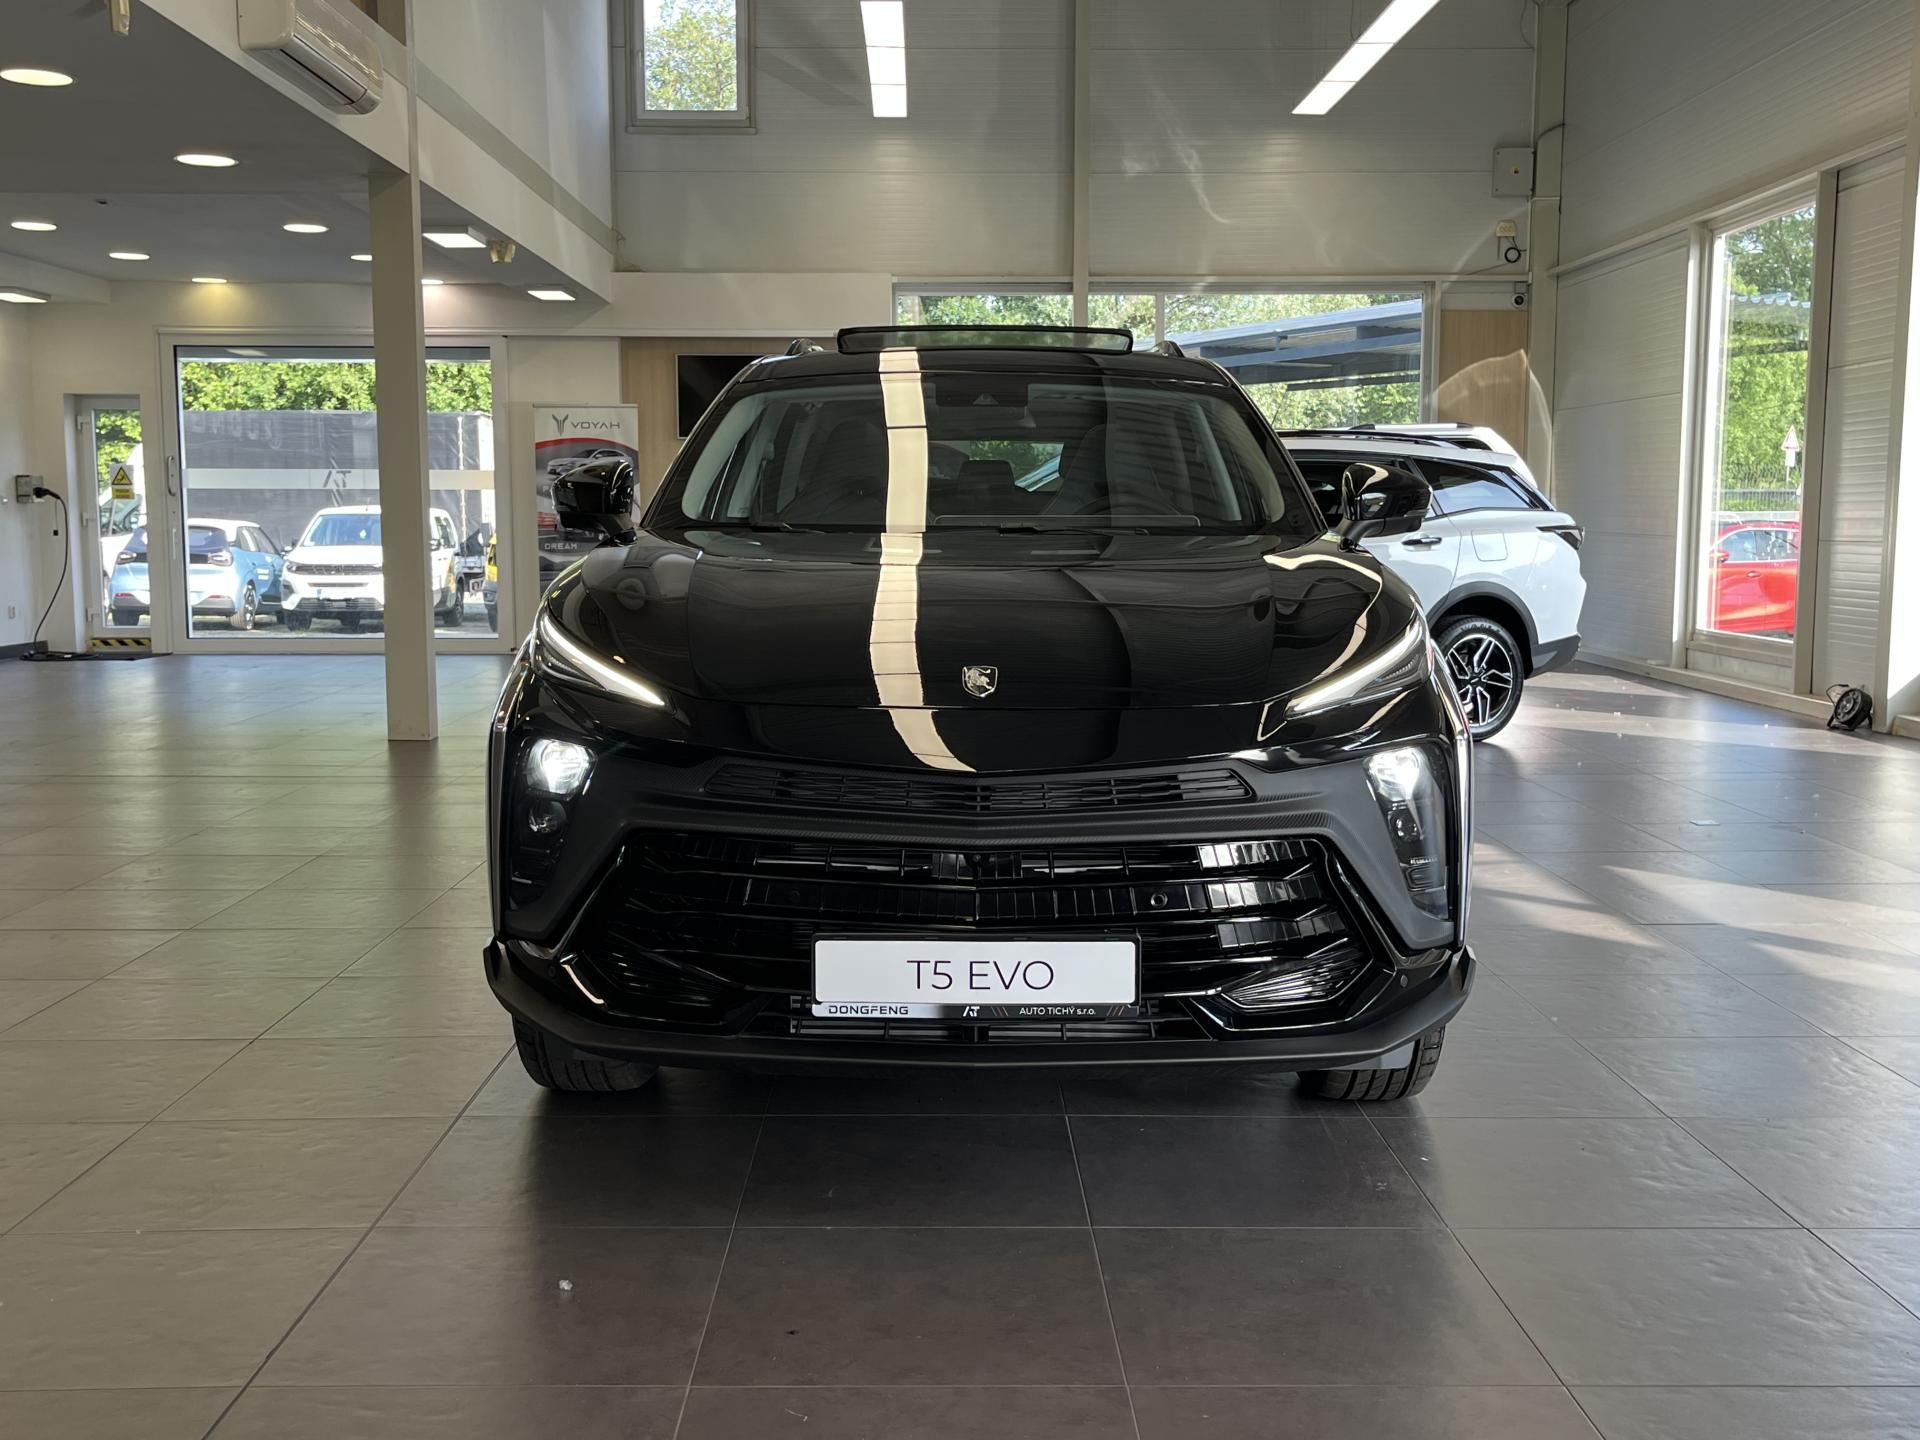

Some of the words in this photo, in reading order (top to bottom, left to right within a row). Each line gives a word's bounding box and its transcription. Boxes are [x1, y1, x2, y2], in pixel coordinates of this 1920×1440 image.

[570, 421, 621, 430] VOYAH
[544, 542, 578, 550] DREAM
[906, 960, 953, 990] T5
[969, 960, 1054, 990] EVO
[828, 1005, 909, 1015] DONGFENG
[1019, 1006, 1046, 1015] AUTO
[1047, 1005, 1075, 1015] TICHÝ
[1076, 1007, 1096, 1016] s.r.o.
